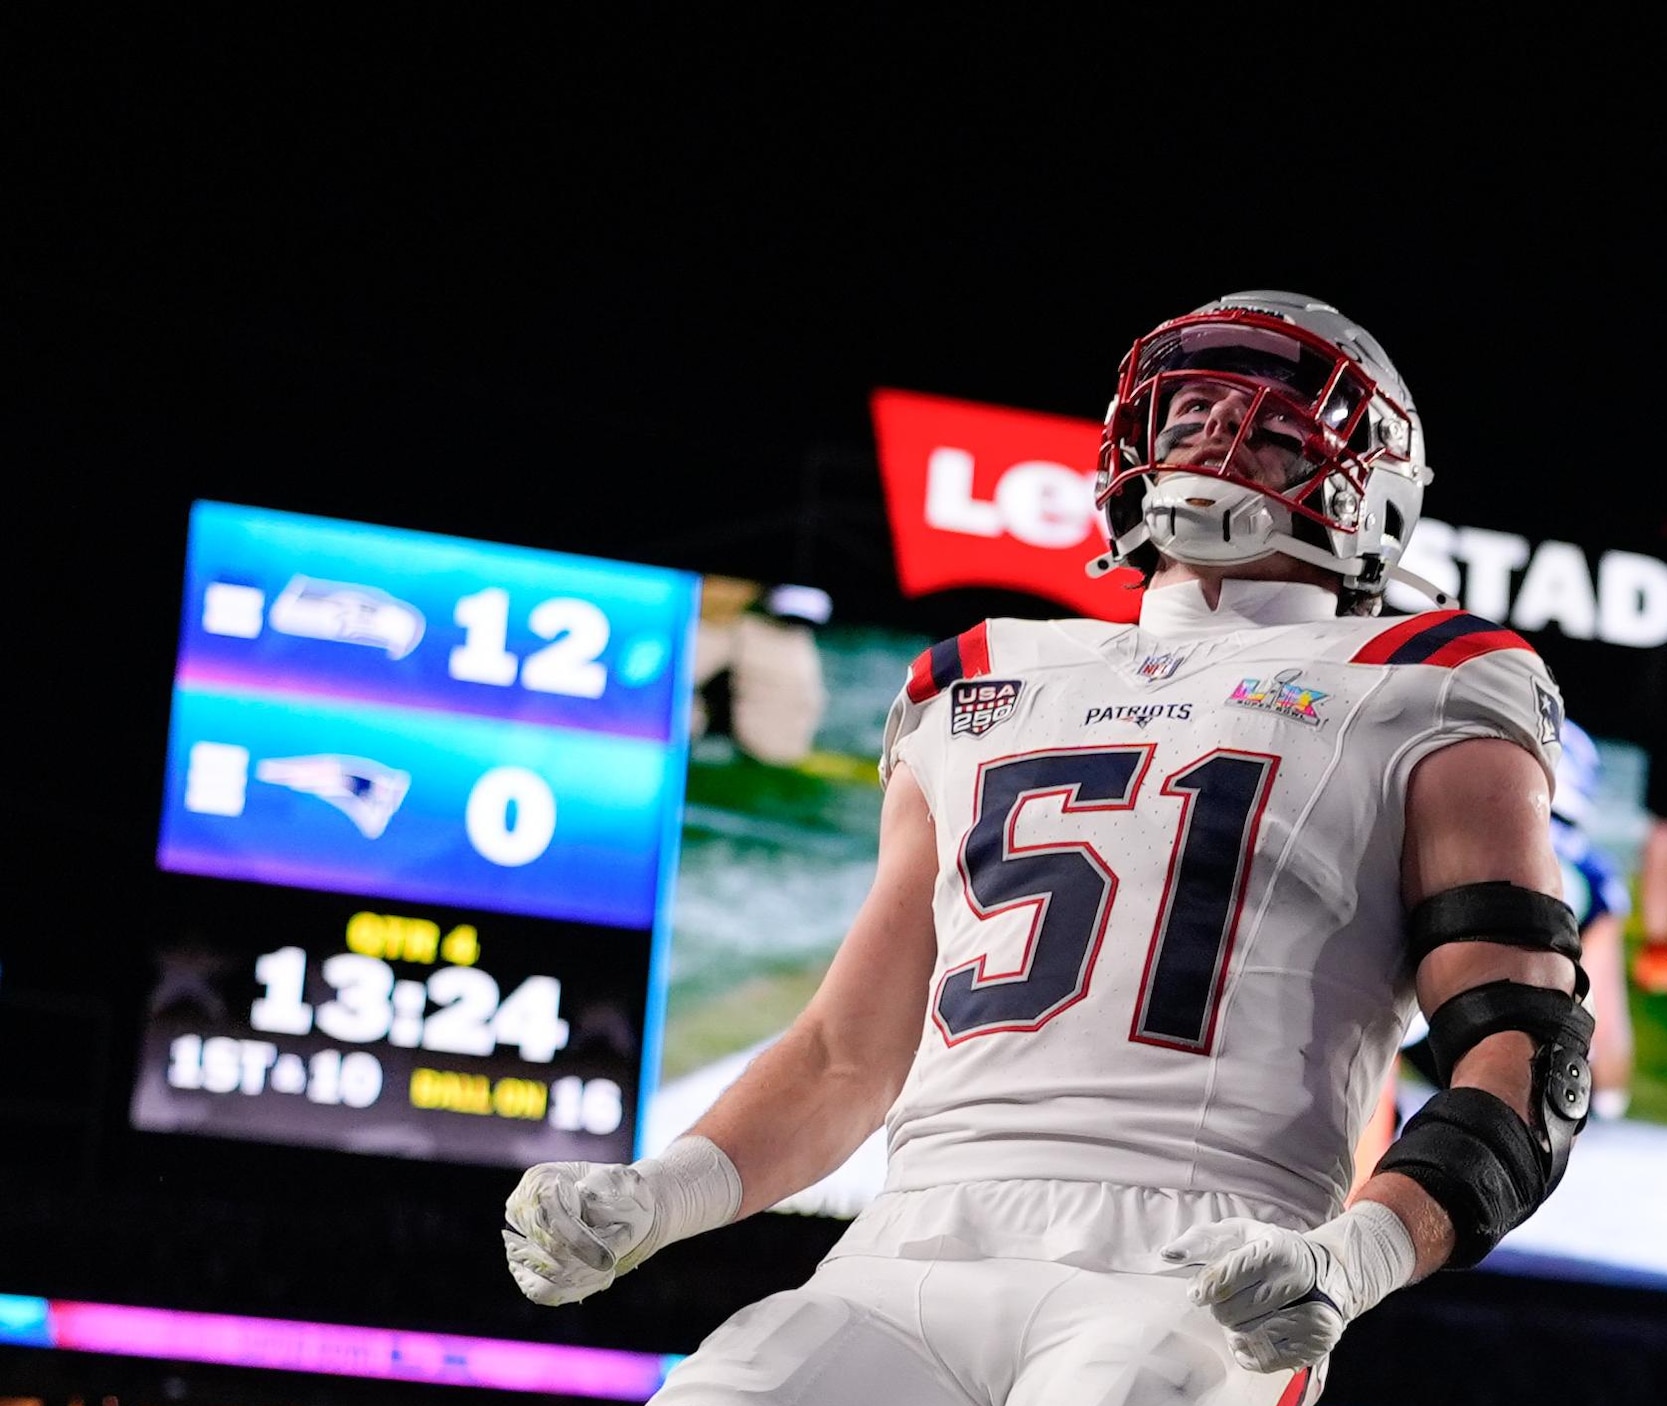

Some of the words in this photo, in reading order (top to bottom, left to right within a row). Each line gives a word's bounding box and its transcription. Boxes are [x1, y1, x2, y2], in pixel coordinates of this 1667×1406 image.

[448, 587, 611, 699] 12
[953, 704, 1014, 733] 250
[958, 684, 1016, 703] USA
[1085, 703, 1193, 725] PATRIOTS
[465, 765, 557, 868] 0
[932, 743, 1281, 1057] 51
[442, 924, 480, 965] 4
[250, 947, 567, 1062] 13:24
